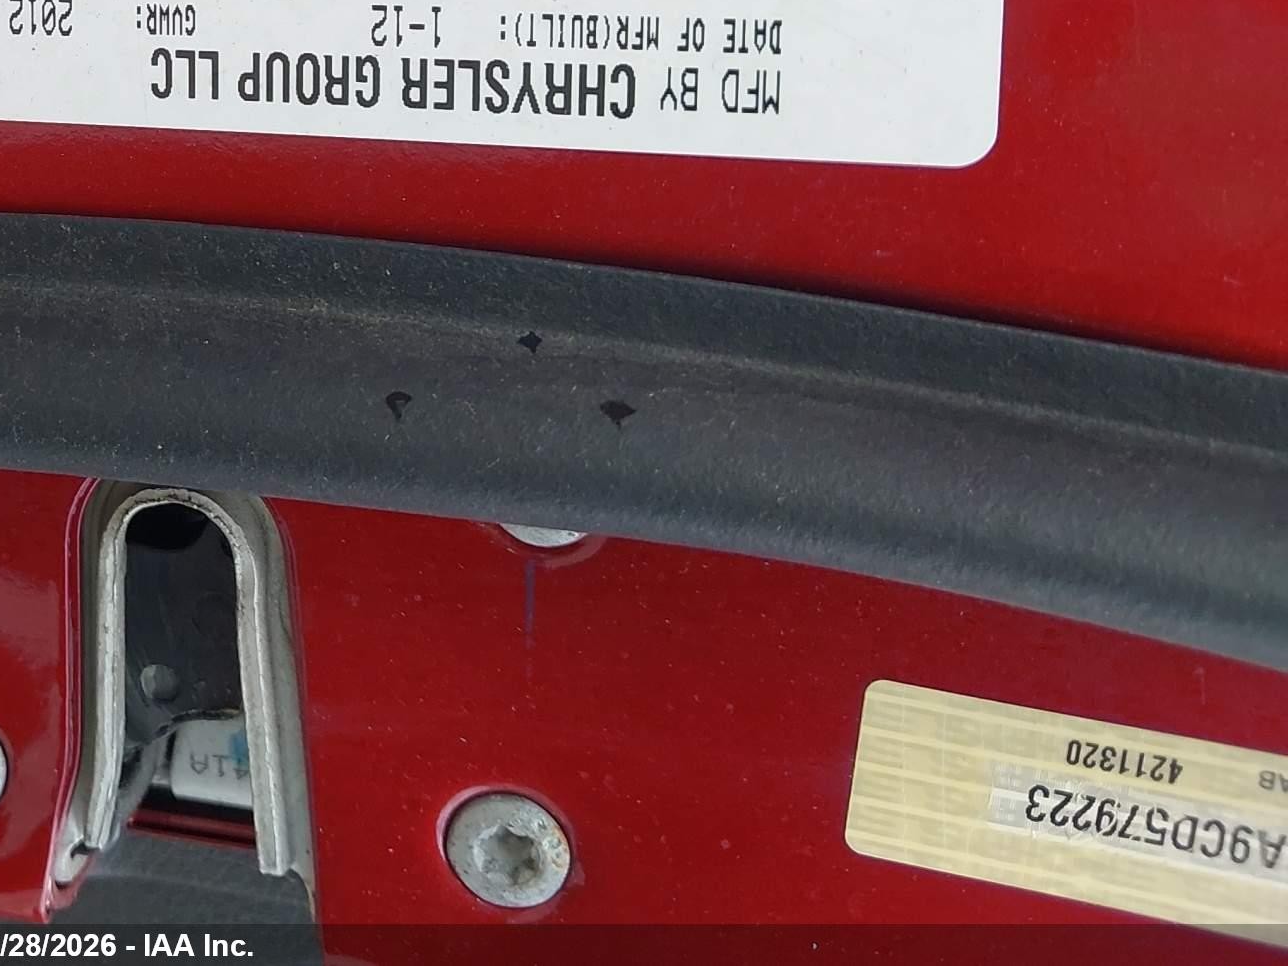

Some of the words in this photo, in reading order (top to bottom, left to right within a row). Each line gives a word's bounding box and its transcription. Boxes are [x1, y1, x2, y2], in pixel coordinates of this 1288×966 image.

[137, 4, 195, 36] GVWR:
[371, 5, 441, 48] 1-12
[500, 13, 659, 50] MFR(BUILT):
[677, 18, 705, 52] OF
[723, 18, 782, 55] DATE
[151, 48, 219, 100] LLC
[238, 52, 380, 108] GROUP
[401, 58, 635, 119] CHRYSLER
[660, 67, 698, 111] BY
[722, 69, 781, 114] MFD
[1066, 739, 1183, 784] 4211320
